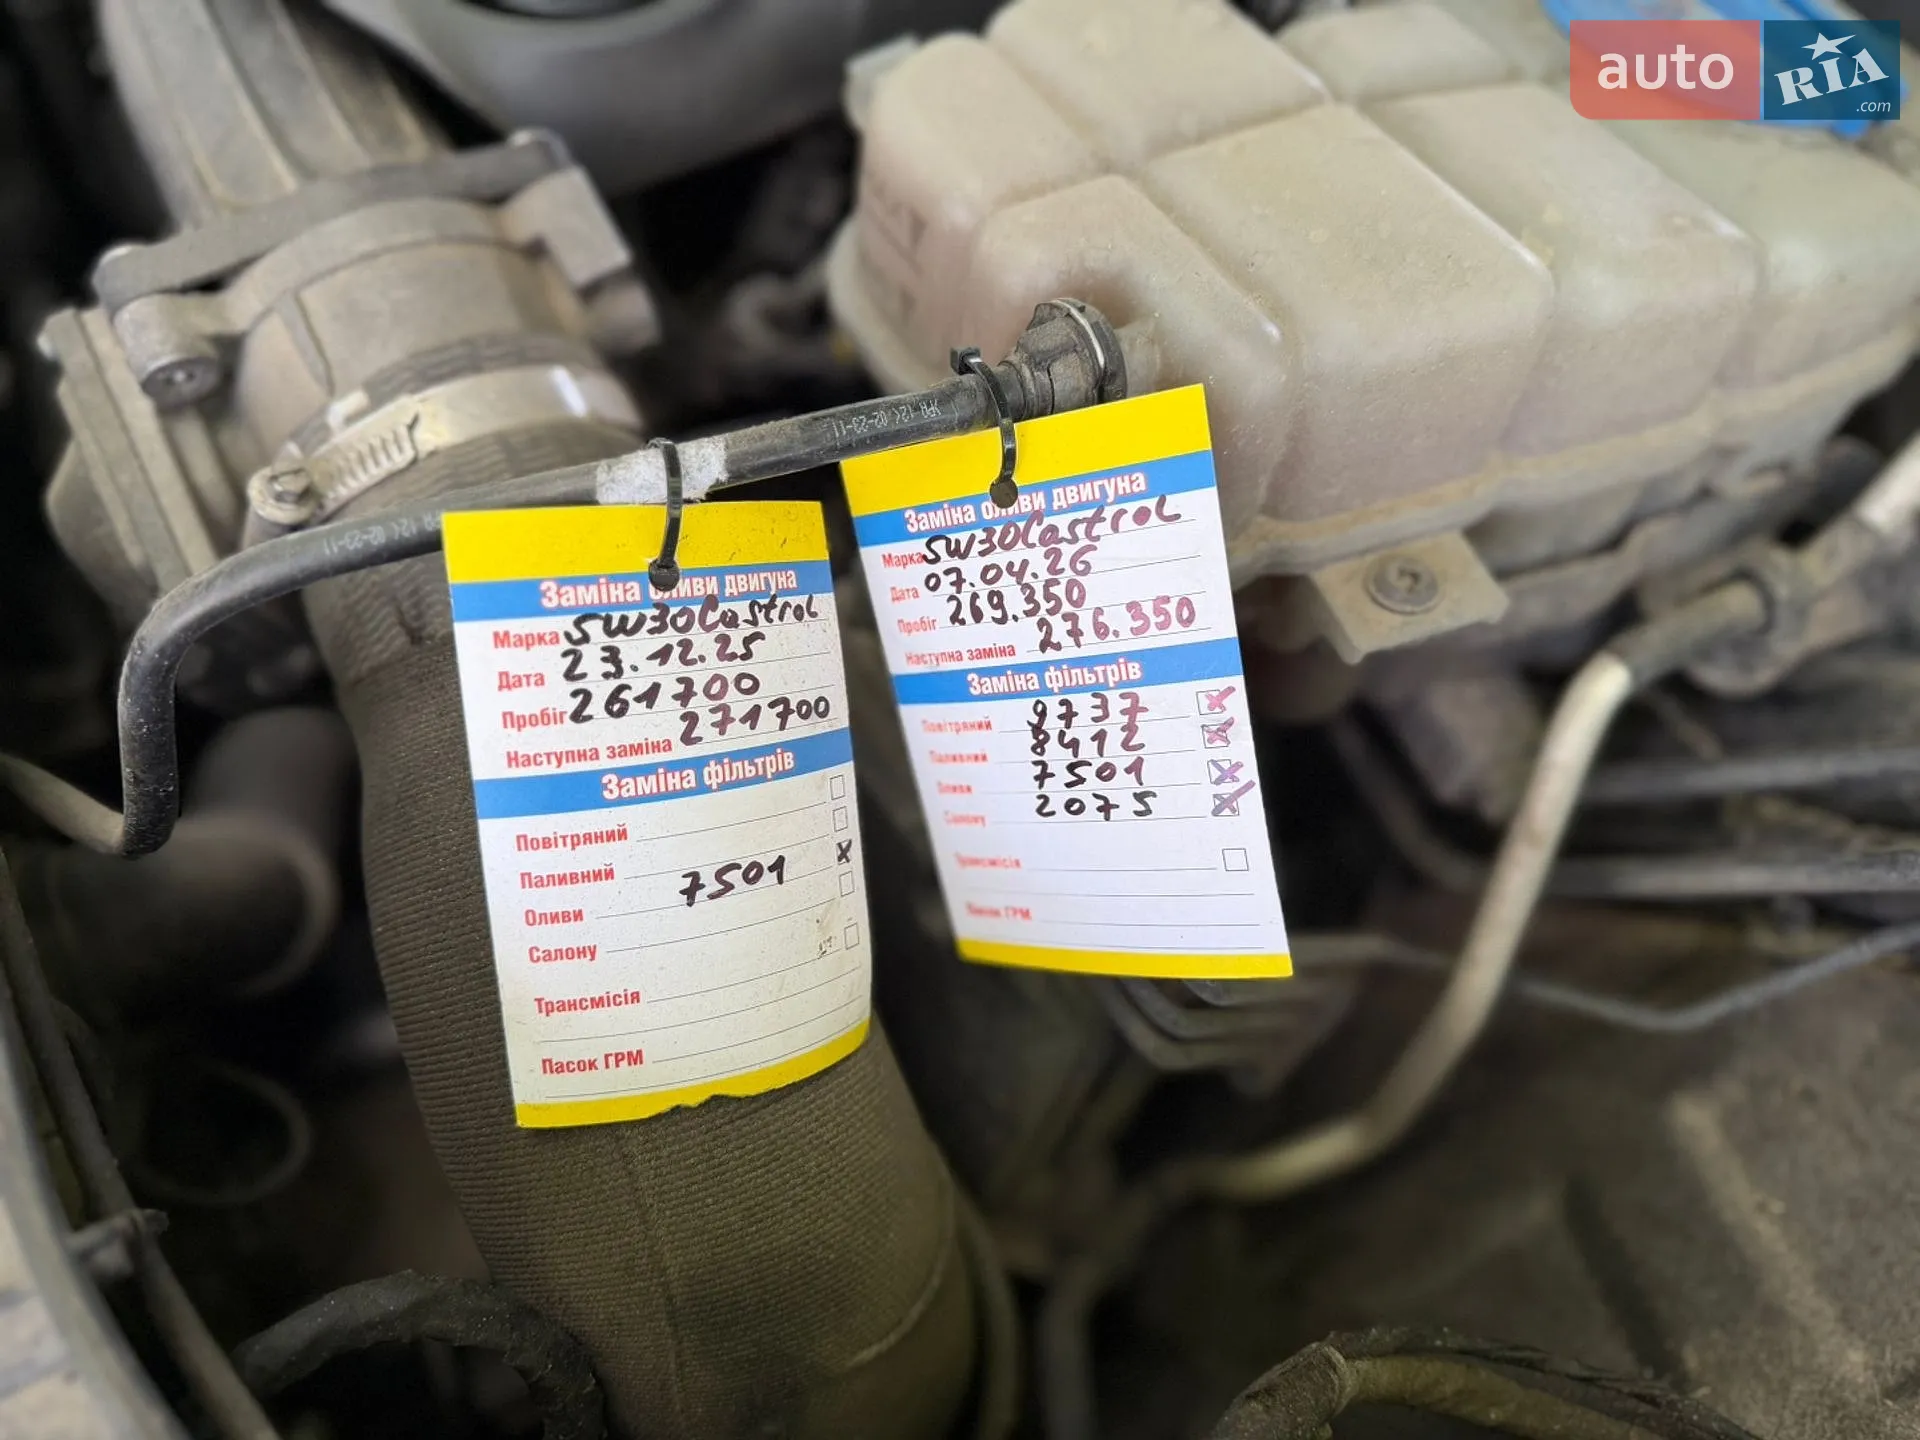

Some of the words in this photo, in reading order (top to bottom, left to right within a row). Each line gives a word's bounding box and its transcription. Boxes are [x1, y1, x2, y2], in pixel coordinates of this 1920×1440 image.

[904, 503, 975, 533] Заміна
[1052, 471, 1147, 511] двигуна
[924, 545, 1098, 593] 07.04.26
[540, 579, 641, 608] Заміна
[725, 569, 798, 597] двигуна
[946, 578, 1086, 627] 269.350
[492, 629, 561, 651] Марка
[1036, 595, 1196, 653] 276.350
[561, 632, 766, 683] 23.12.25
[966, 643, 1017, 661] заміна
[497, 671, 545, 692] Дата
[967, 671, 1040, 697] Заміна
[1045, 658, 1142, 690] фільтрів
[569, 672, 761, 726] 261700
[501, 707, 567, 730] Пробіг
[678, 695, 830, 747] 271700
[506, 745, 600, 769] Наступна
[606, 737, 673, 759] заміна
[601, 768, 697, 801] Заміна
[702, 748, 795, 792] фільтрів
[1031, 756, 1144, 788] 7501
[1035, 790, 1158, 821] 2075
[516, 823, 629, 853] Повітряний
[519, 863, 615, 890] Паливний
[678, 855, 786, 907] 7501
[524, 908, 584, 927] Оливи
[528, 944, 597, 965] Салону
[534, 989, 641, 1015] Трансмісія
[541, 1056, 598, 1076] Пасок
[604, 1048, 644, 1070] ГРМ
